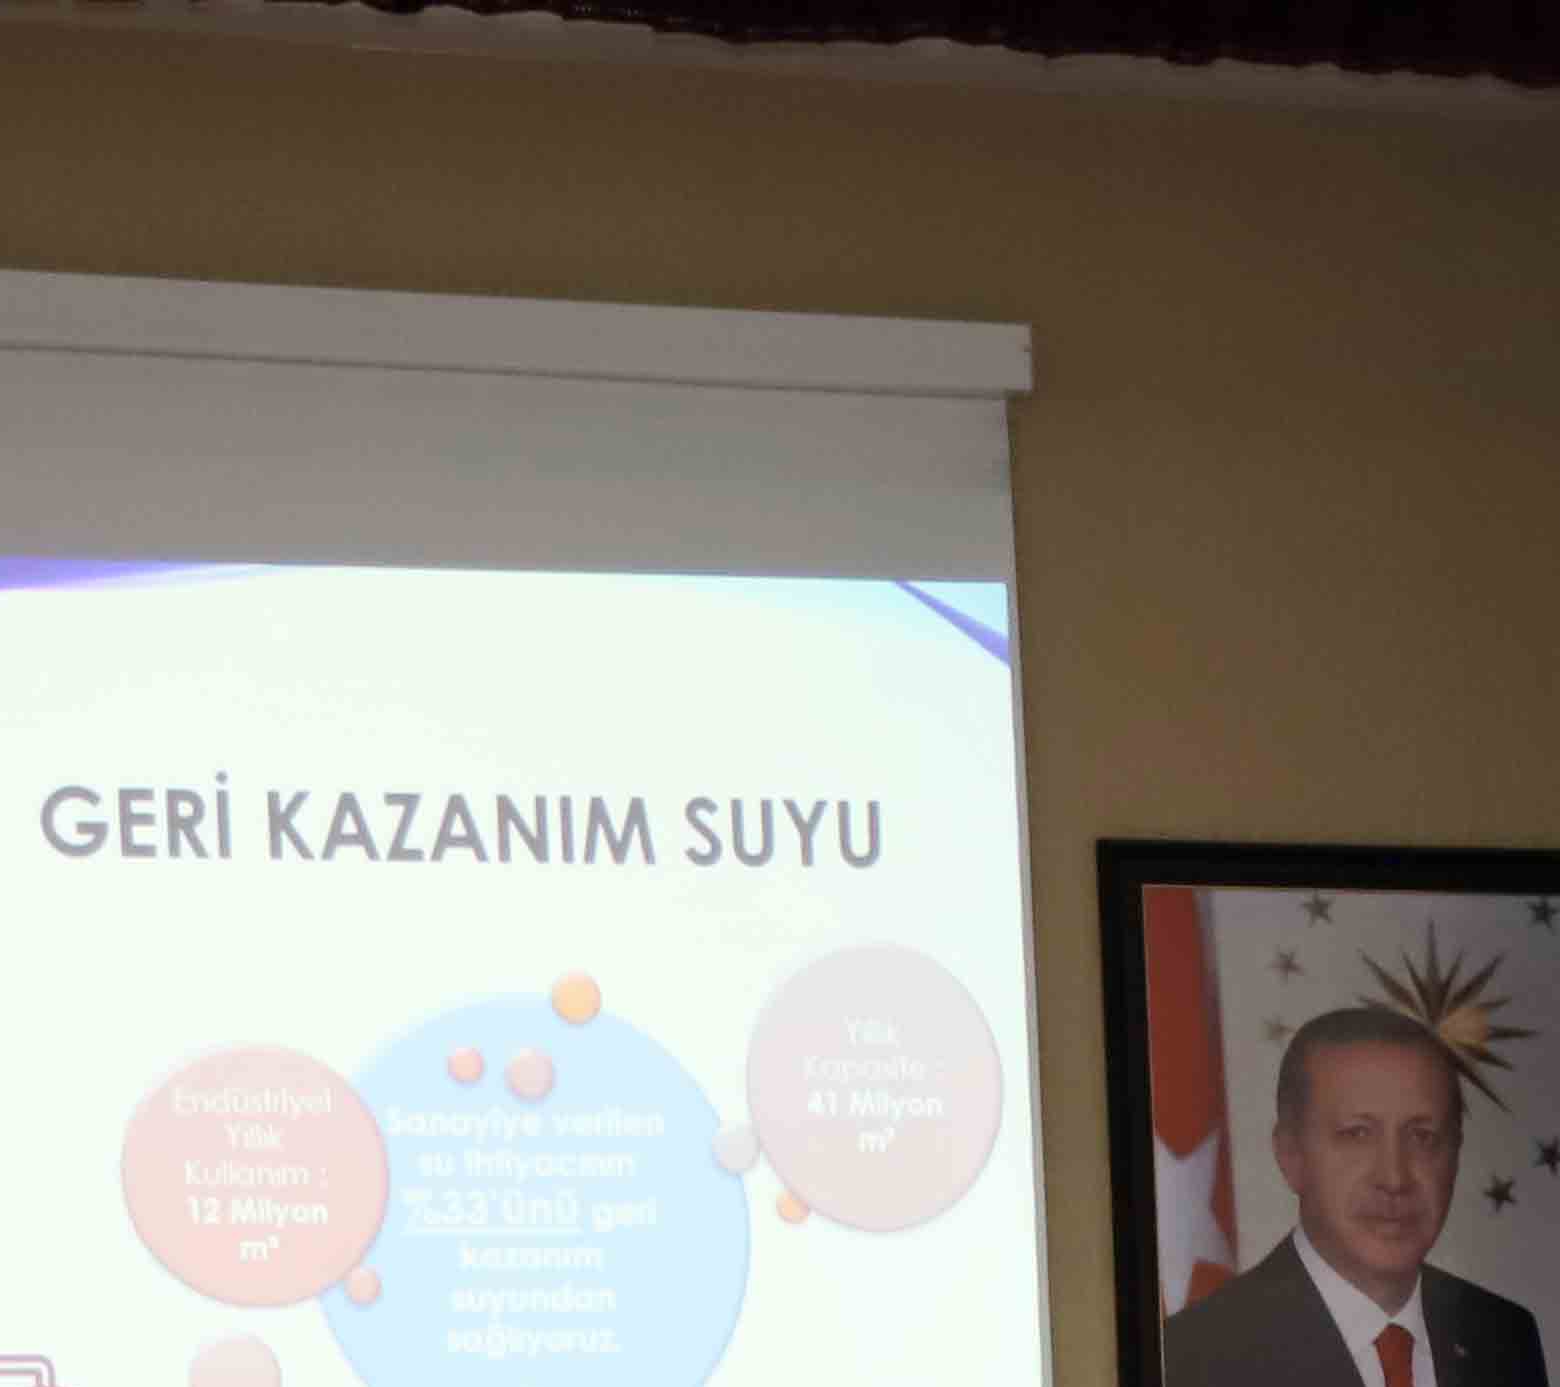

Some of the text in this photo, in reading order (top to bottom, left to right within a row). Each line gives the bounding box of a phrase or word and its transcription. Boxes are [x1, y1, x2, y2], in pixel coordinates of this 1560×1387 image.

[40, 769, 883, 868] GERİ KAZANIM SUYU
[848, 1089, 944, 1122] Milyon
[187, 1195, 328, 1231] 12 Milyon
